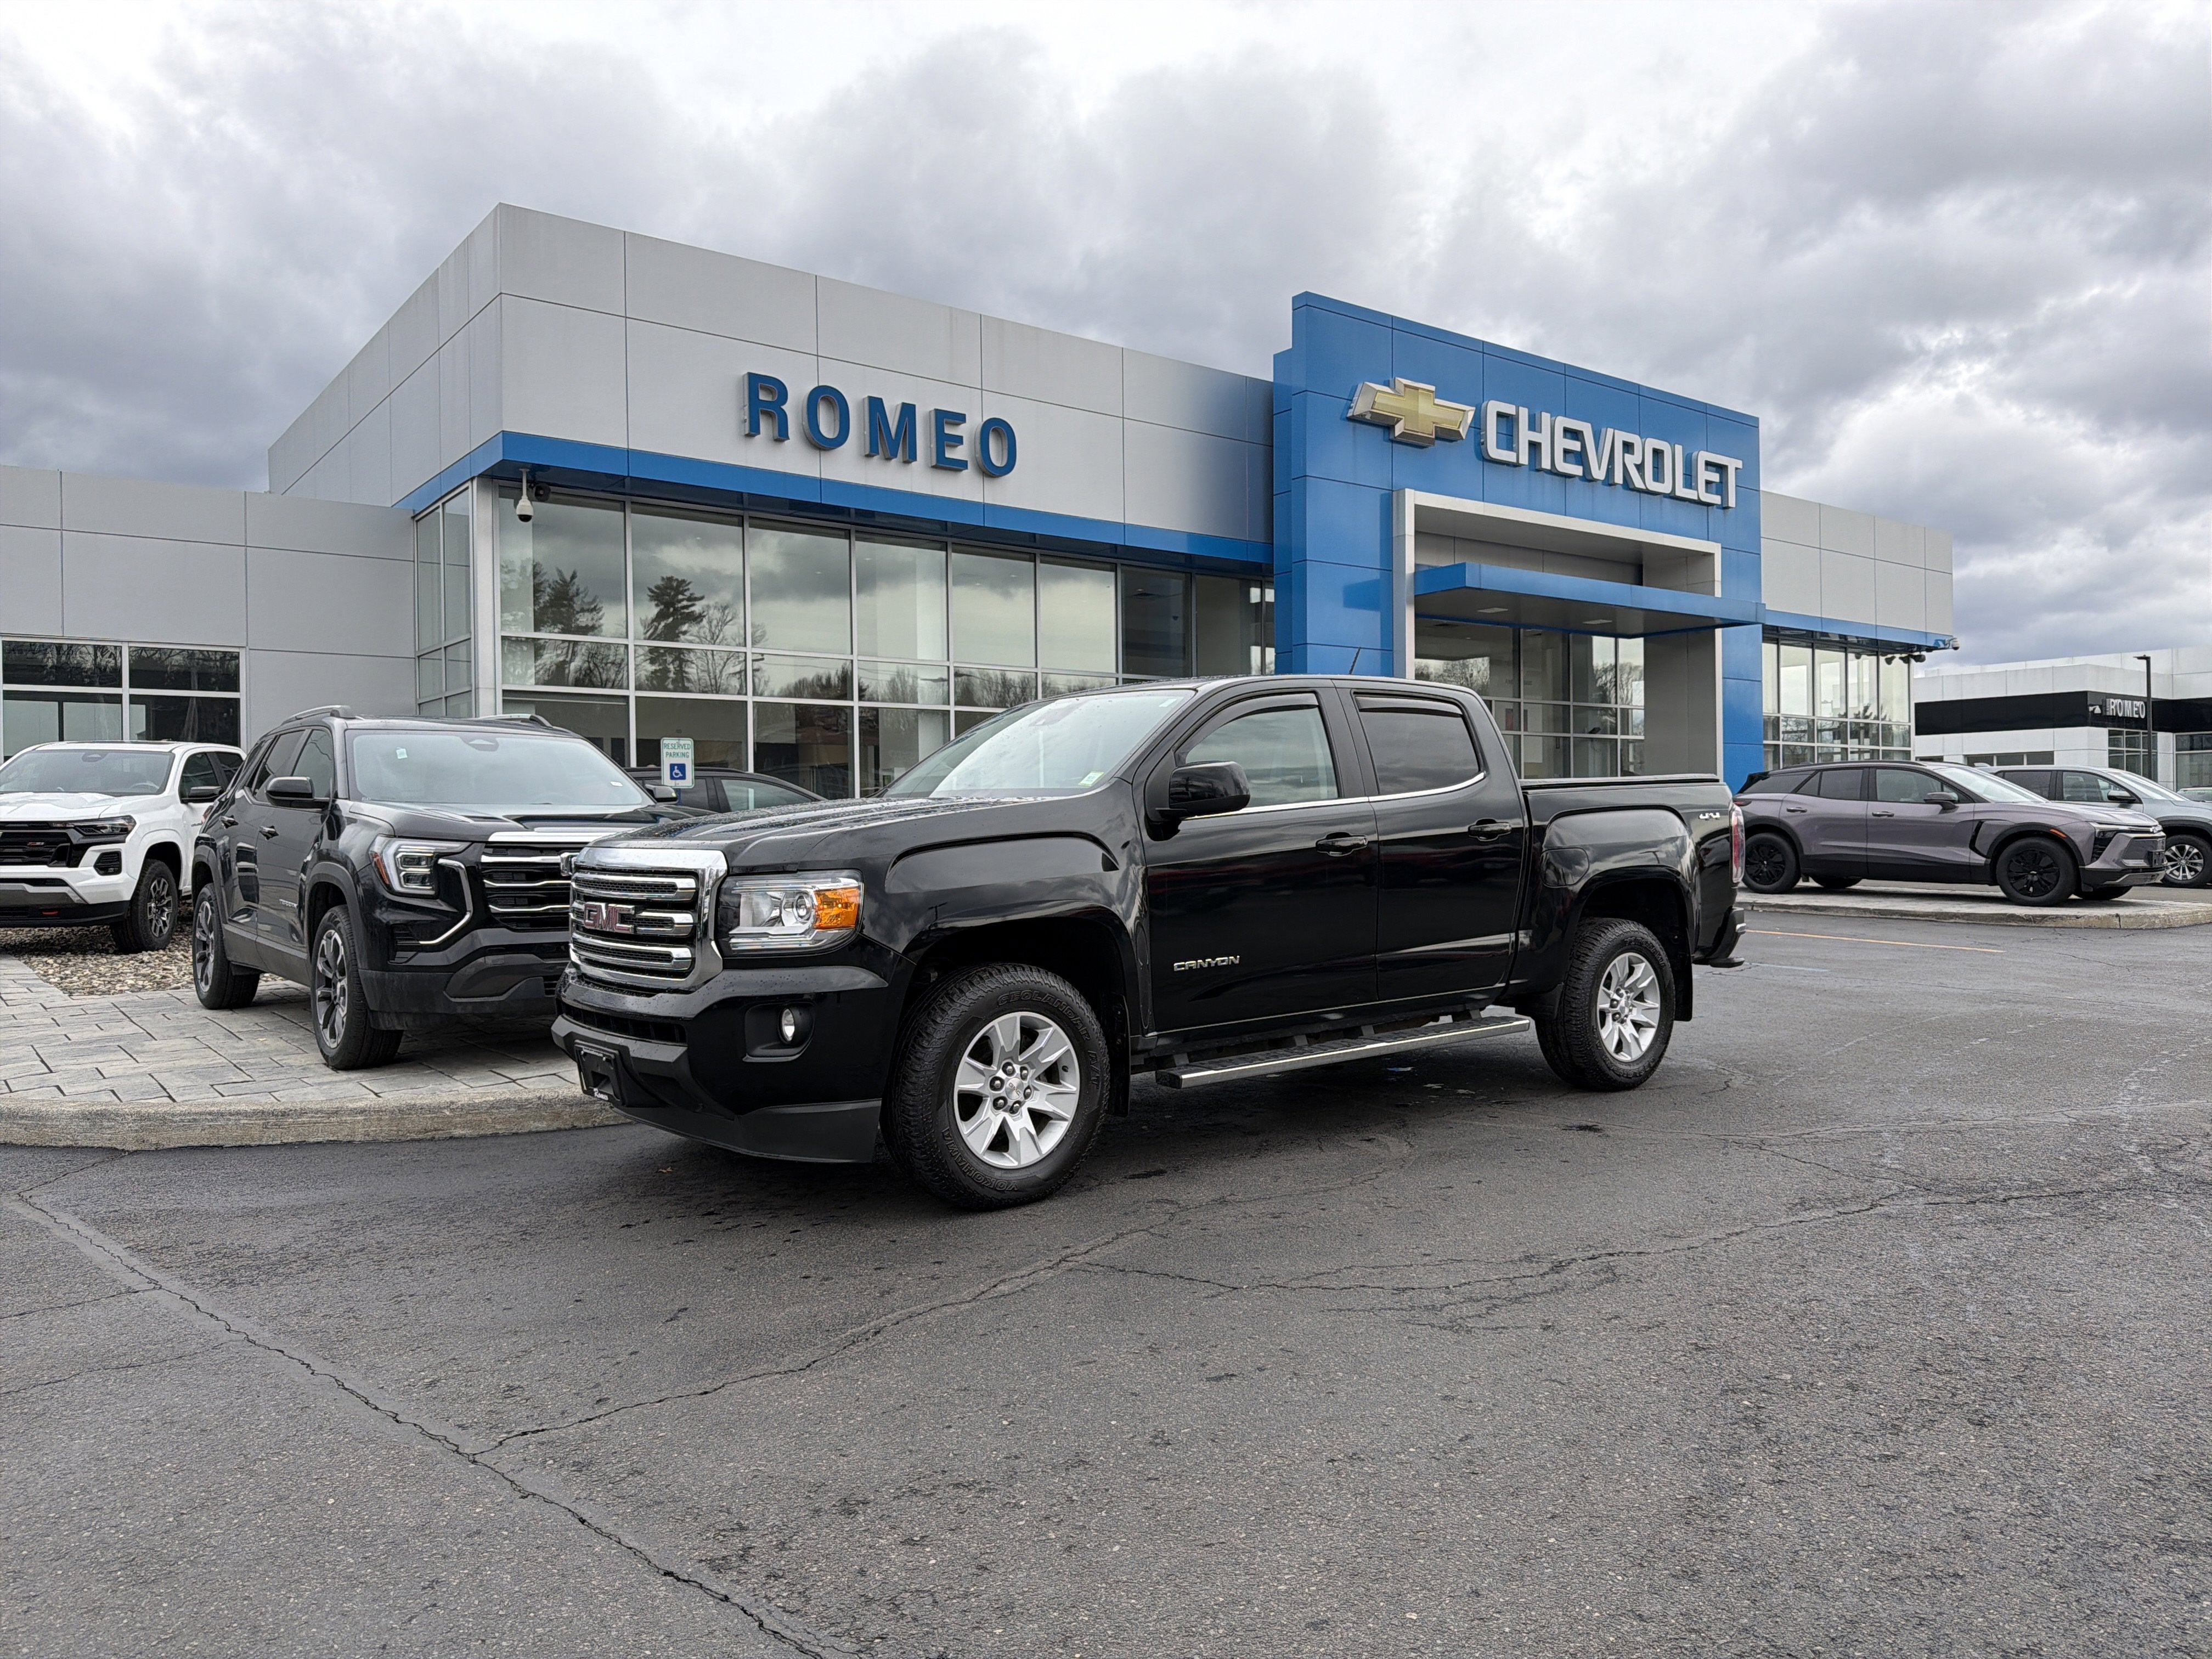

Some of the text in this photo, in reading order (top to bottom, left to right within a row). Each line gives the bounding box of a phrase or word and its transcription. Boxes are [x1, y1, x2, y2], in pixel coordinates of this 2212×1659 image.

[743, 371, 1017, 477] ROMEO
[1481, 399, 1743, 509] CHEVROLET
[2107, 698, 2146, 719] ROMEO
[584, 901, 636, 934] GMC
[1173, 955, 1240, 972] CANYON
[997, 989, 1091, 1041] GEOLANDAR
[1008, 1082, 1022, 1096] GMC
[941, 1126, 1019, 1191] YOKOHAMA
